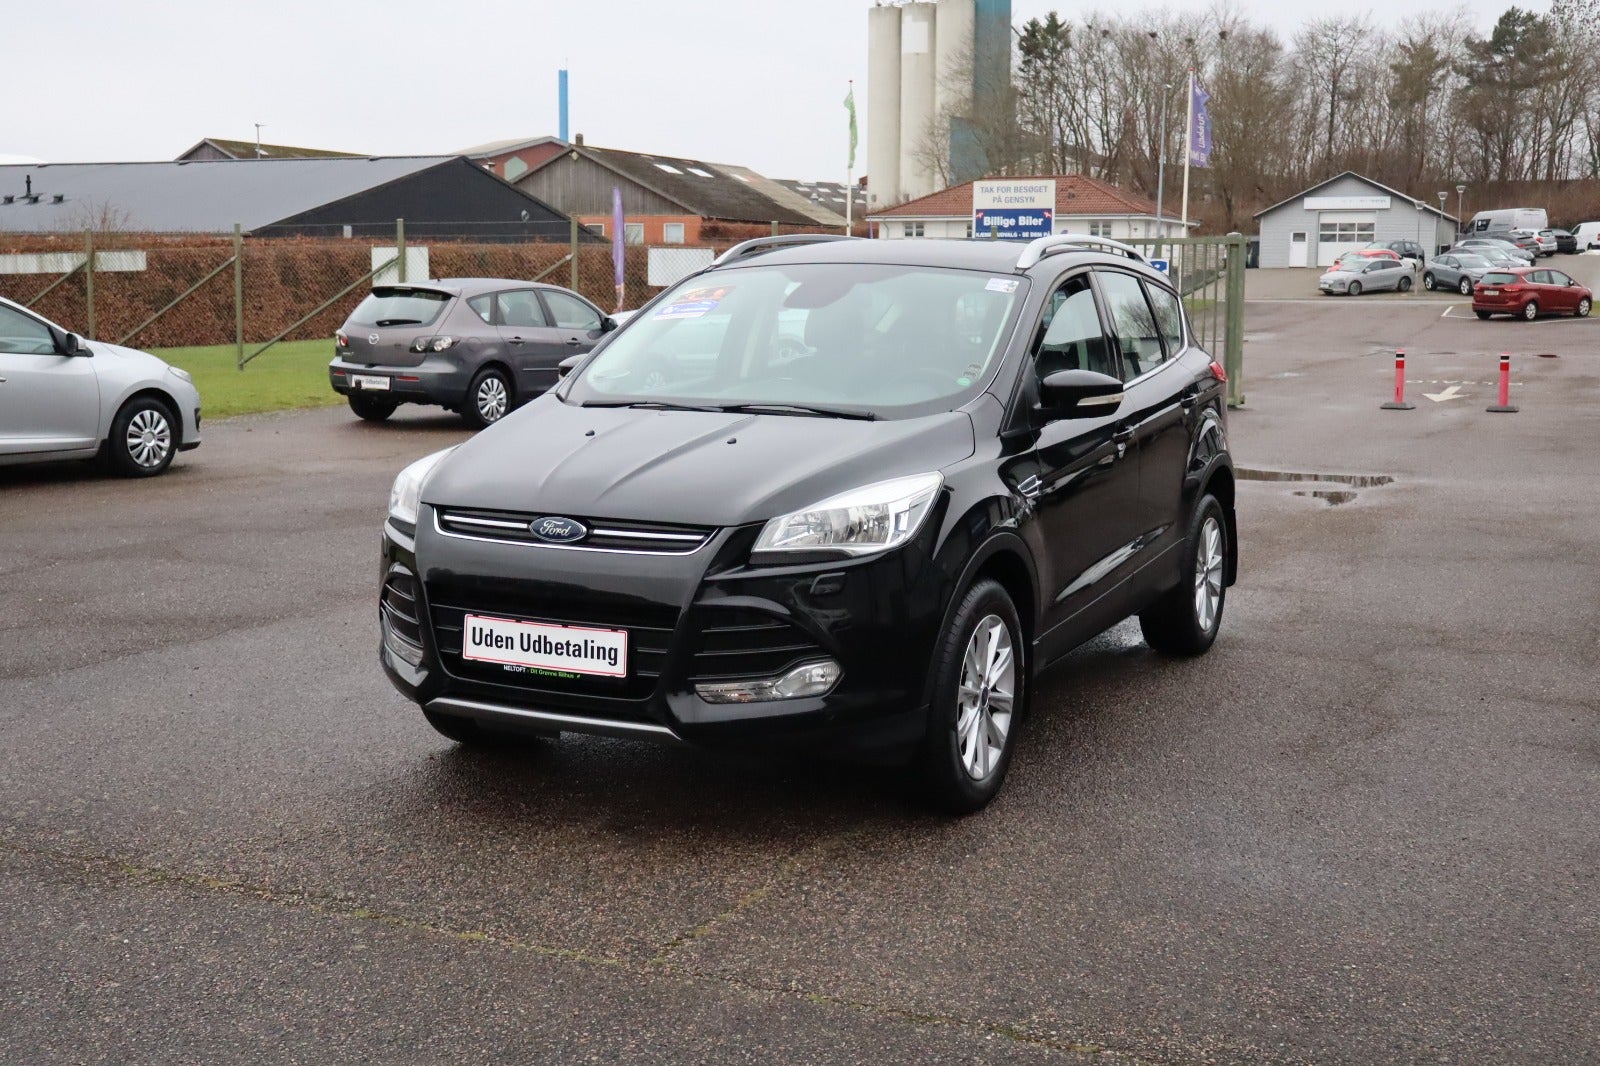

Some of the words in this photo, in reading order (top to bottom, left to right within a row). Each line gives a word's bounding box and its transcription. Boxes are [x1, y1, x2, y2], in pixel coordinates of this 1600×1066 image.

[1014, 185, 1048, 193] BESØGET
[993, 196, 1002, 204] PÅ
[983, 216, 1016, 227] Billige
[1018, 216, 1043, 226] Biler
[540, 519, 572, 537] Ford
[472, 626, 514, 650] Uden
[520, 632, 618, 667] Udbetaling
[503, 664, 526, 673] NELTOFT
